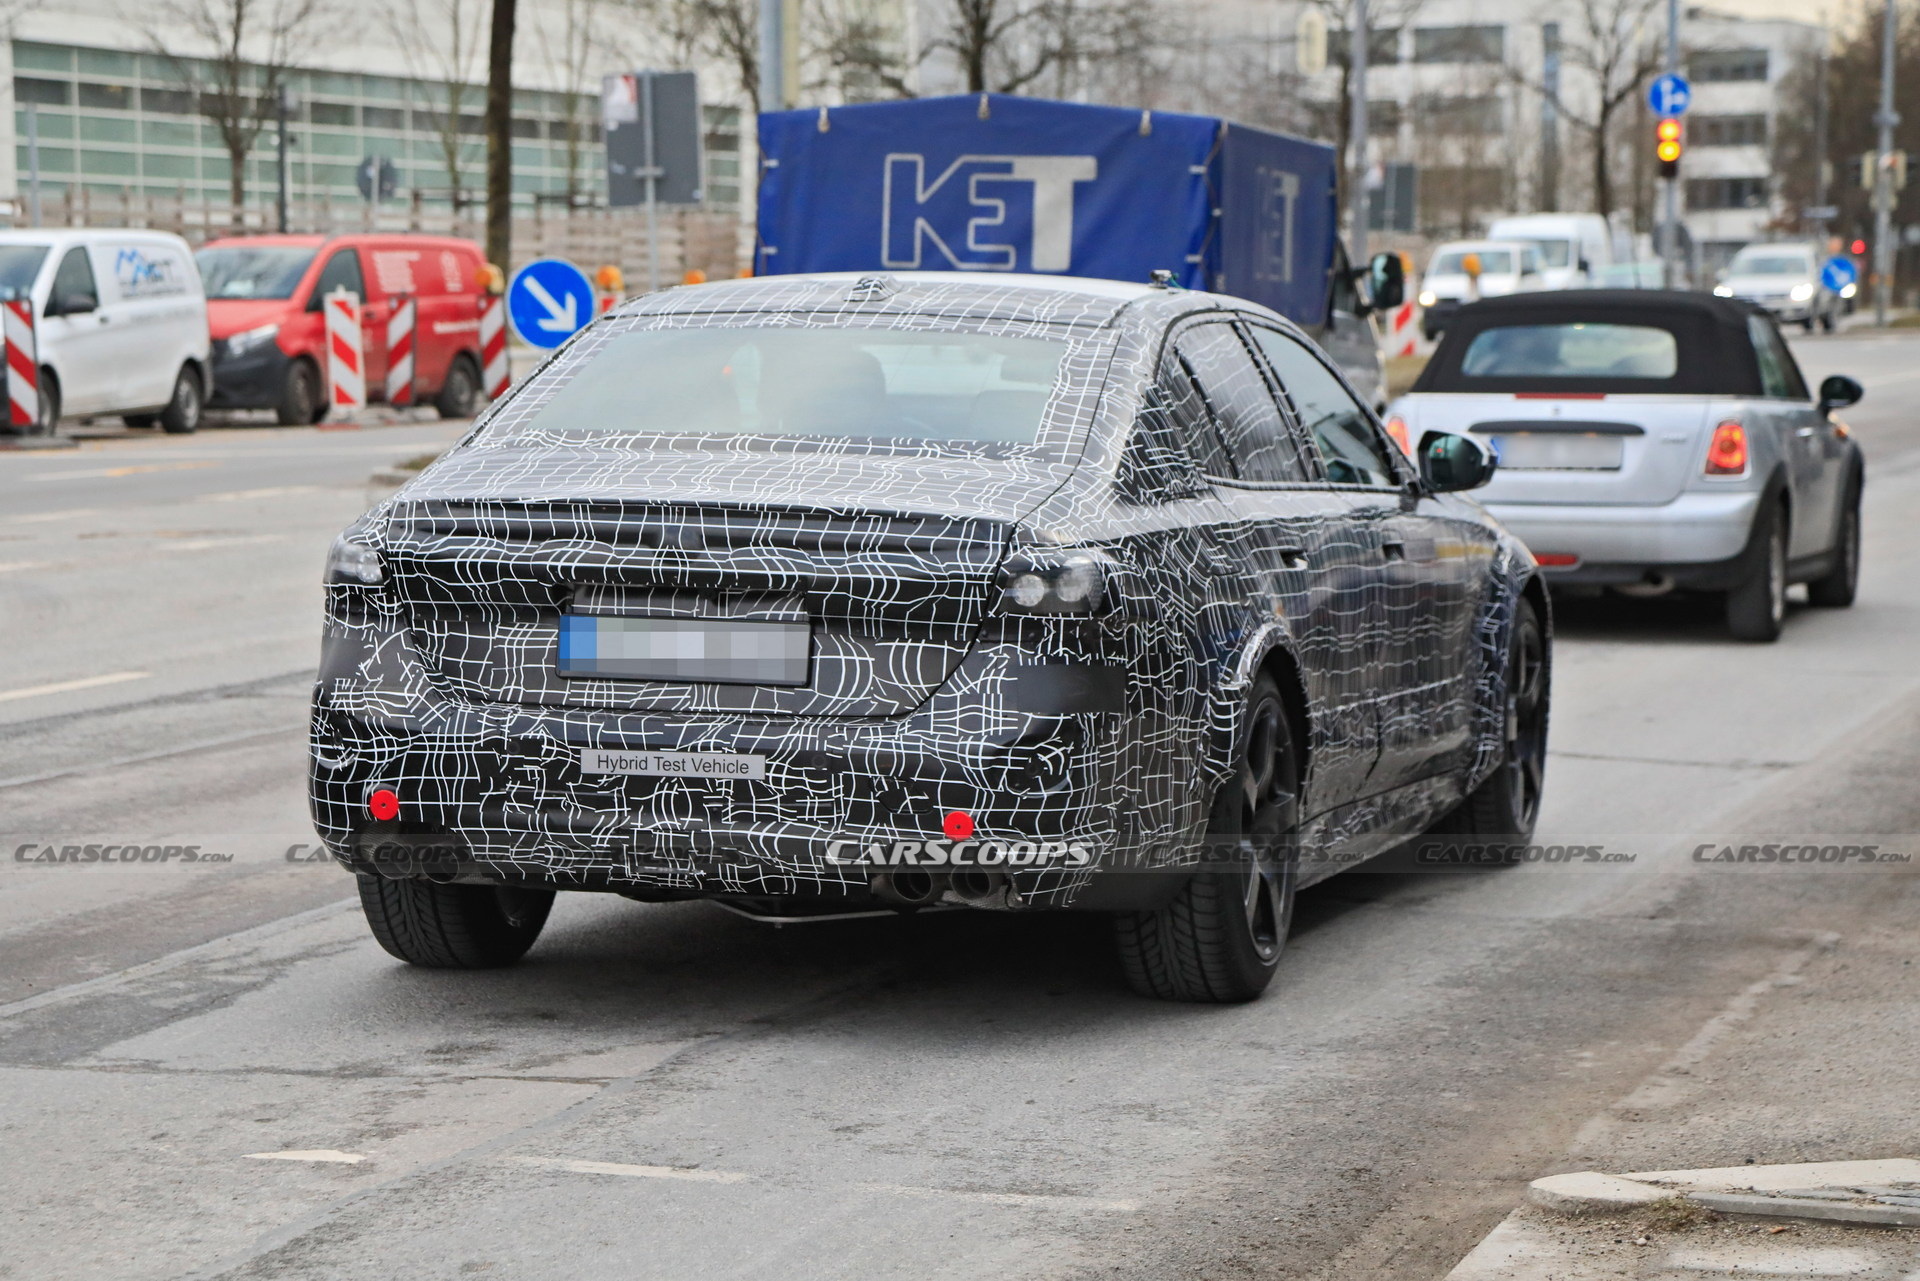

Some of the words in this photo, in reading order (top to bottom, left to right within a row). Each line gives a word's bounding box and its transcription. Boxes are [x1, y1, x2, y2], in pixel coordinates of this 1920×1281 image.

[881, 153, 1098, 272] KET
[597, 755, 648, 773] Hybrid
[653, 756, 687, 772] Test
[691, 758, 749, 774] Vehicle
